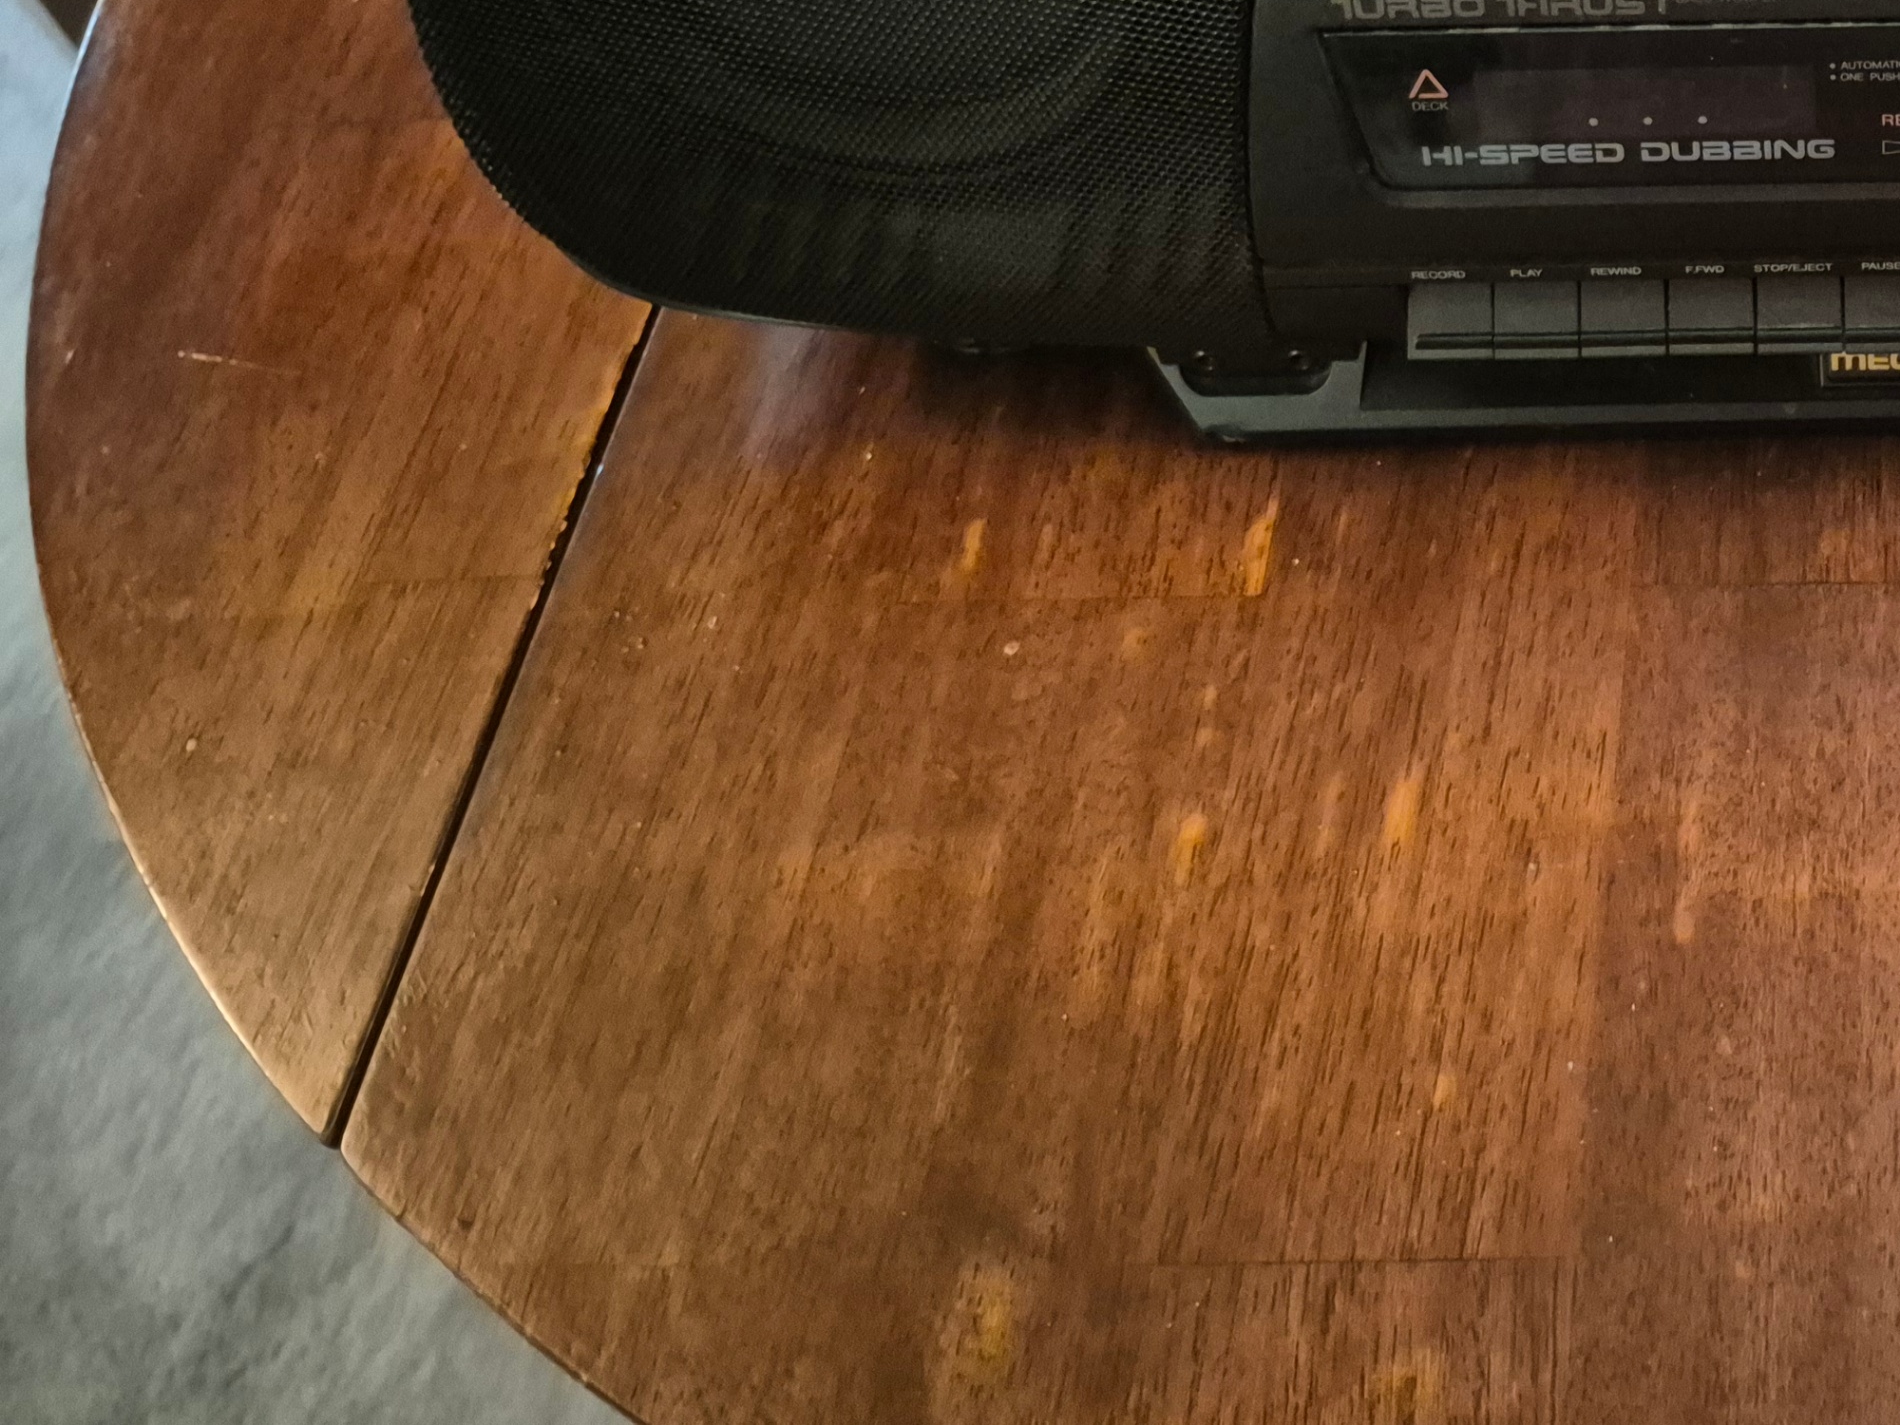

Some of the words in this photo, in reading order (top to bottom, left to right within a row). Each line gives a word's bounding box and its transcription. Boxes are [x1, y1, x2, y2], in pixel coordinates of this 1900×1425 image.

[1840, 72, 1864, 82] ONE
[1870, 71, 1900, 81] PUSH
[1411, 101, 1449, 112] DECK
[1421, 142, 1626, 167] HI-SPEED
[1640, 138, 1836, 163] DUBBING
[1590, 266, 1643, 276] REWIND
[1753, 262, 1833, 273] STOP/EJECT
[1411, 270, 1467, 280] RECORD
[1509, 268, 1543, 279] PLAY
